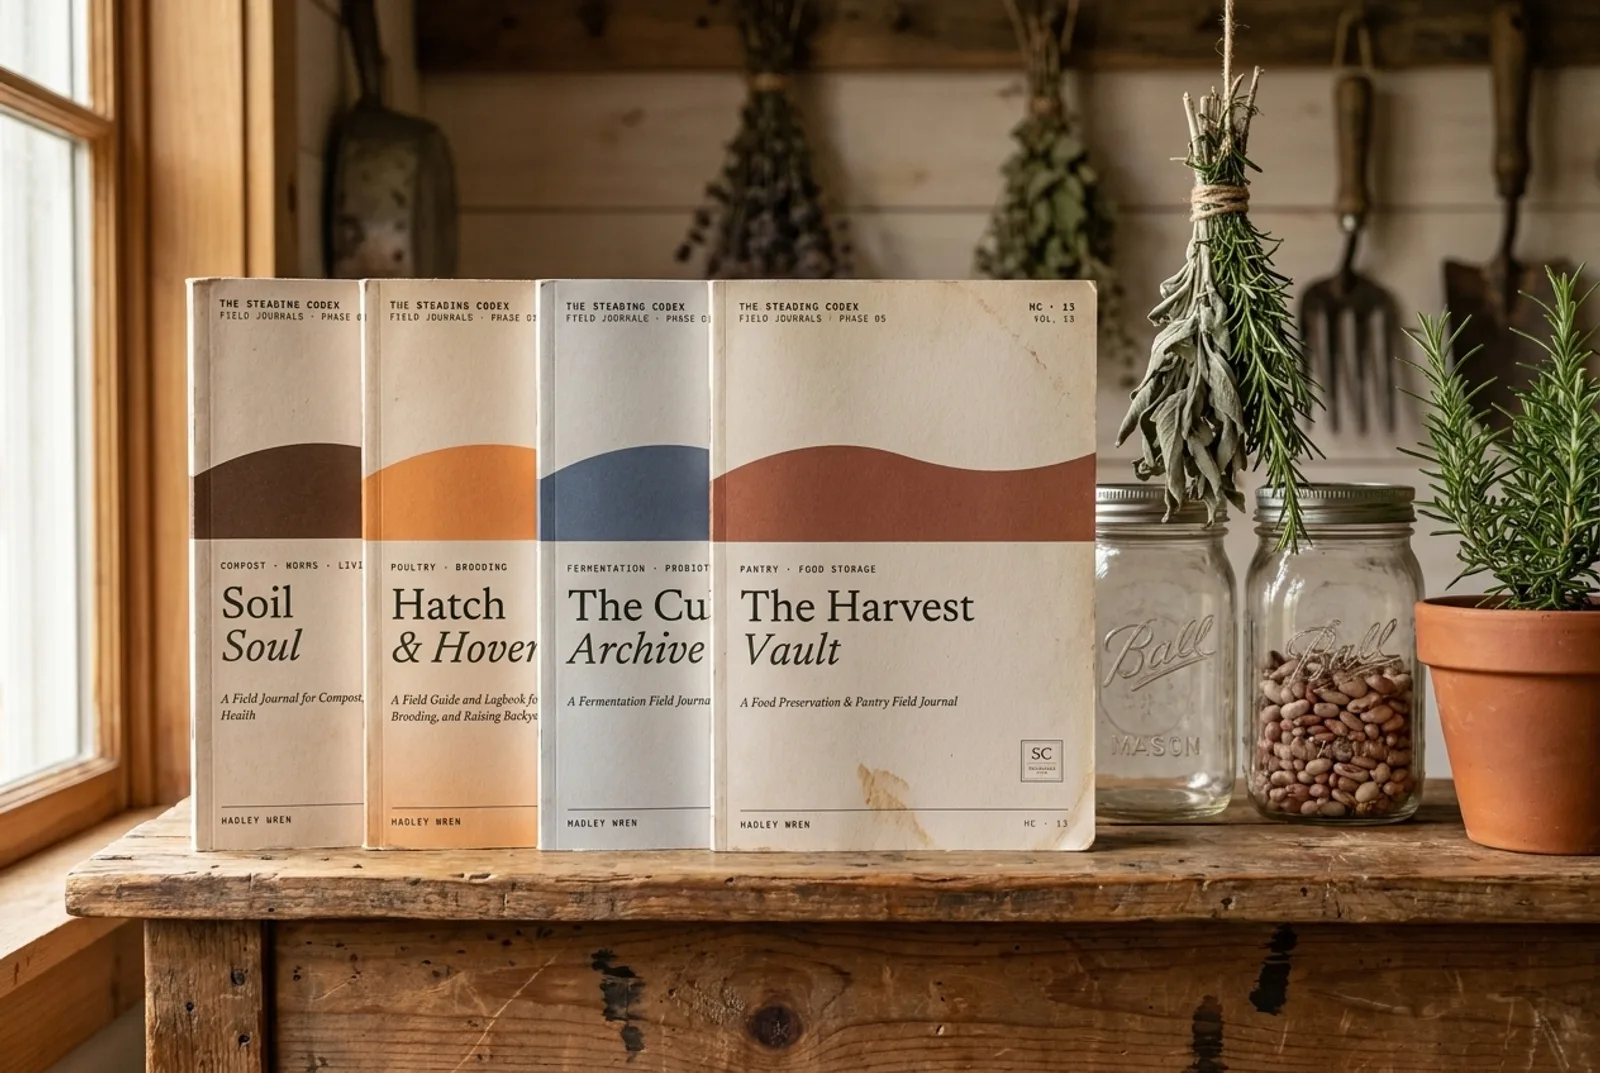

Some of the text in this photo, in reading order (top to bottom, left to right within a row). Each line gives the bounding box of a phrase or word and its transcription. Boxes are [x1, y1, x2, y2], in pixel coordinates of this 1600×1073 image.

[219, 299, 239, 308] THE
[307, 301, 340, 309] CODEX
[390, 301, 409, 310] THE
[476, 302, 510, 310] CODEX
[566, 302, 585, 311] THE
[652, 303, 685, 312] CODEX
[739, 303, 758, 311] THE
[826, 303, 859, 311] CODEX
[322, 312, 350, 321] PHASE
[840, 314, 868, 323] PHASE
[391, 563, 436, 571] POULTRY
[567, 564, 645, 573] FERMENTATION
[740, 565, 779, 573] PANTRY
[831, 565, 876, 573] STORAGE
[222, 584, 294, 619] Soil
[392, 586, 506, 620] Hatch
[568, 588, 643, 621] The
[740, 588, 975, 622] The Harvest
[222, 628, 303, 662] Soul
[392, 631, 538, 663] & Hover
[566, 631, 705, 664] Archive
[745, 632, 842, 666] Vault
[1103, 614, 1216, 688] Ball
[220, 694, 229, 704] A
[260, 692, 299, 706] Journal
[299, 692, 316, 706] for
[391, 695, 399, 705] A
[402, 694, 428, 705] Field
[430, 694, 461, 705] Guide
[462, 694, 480, 705] and
[567, 696, 575, 706] A
[579, 696, 646, 706] Fermentation
[649, 696, 674, 706] Field
[740, 698, 748, 708] A
[779, 696, 841, 708] Preservation
[844, 696, 852, 708] &
[855, 696, 889, 710] Pantry
[892, 696, 917, 707] Field
[918, 696, 958, 709] Journal
[391, 711, 440, 724] Brooding,
[442, 711, 461, 722] and
[464, 711, 501, 724] Raising
[1112, 735, 1200, 757] MASON
[1031, 747, 1052, 760] SC
